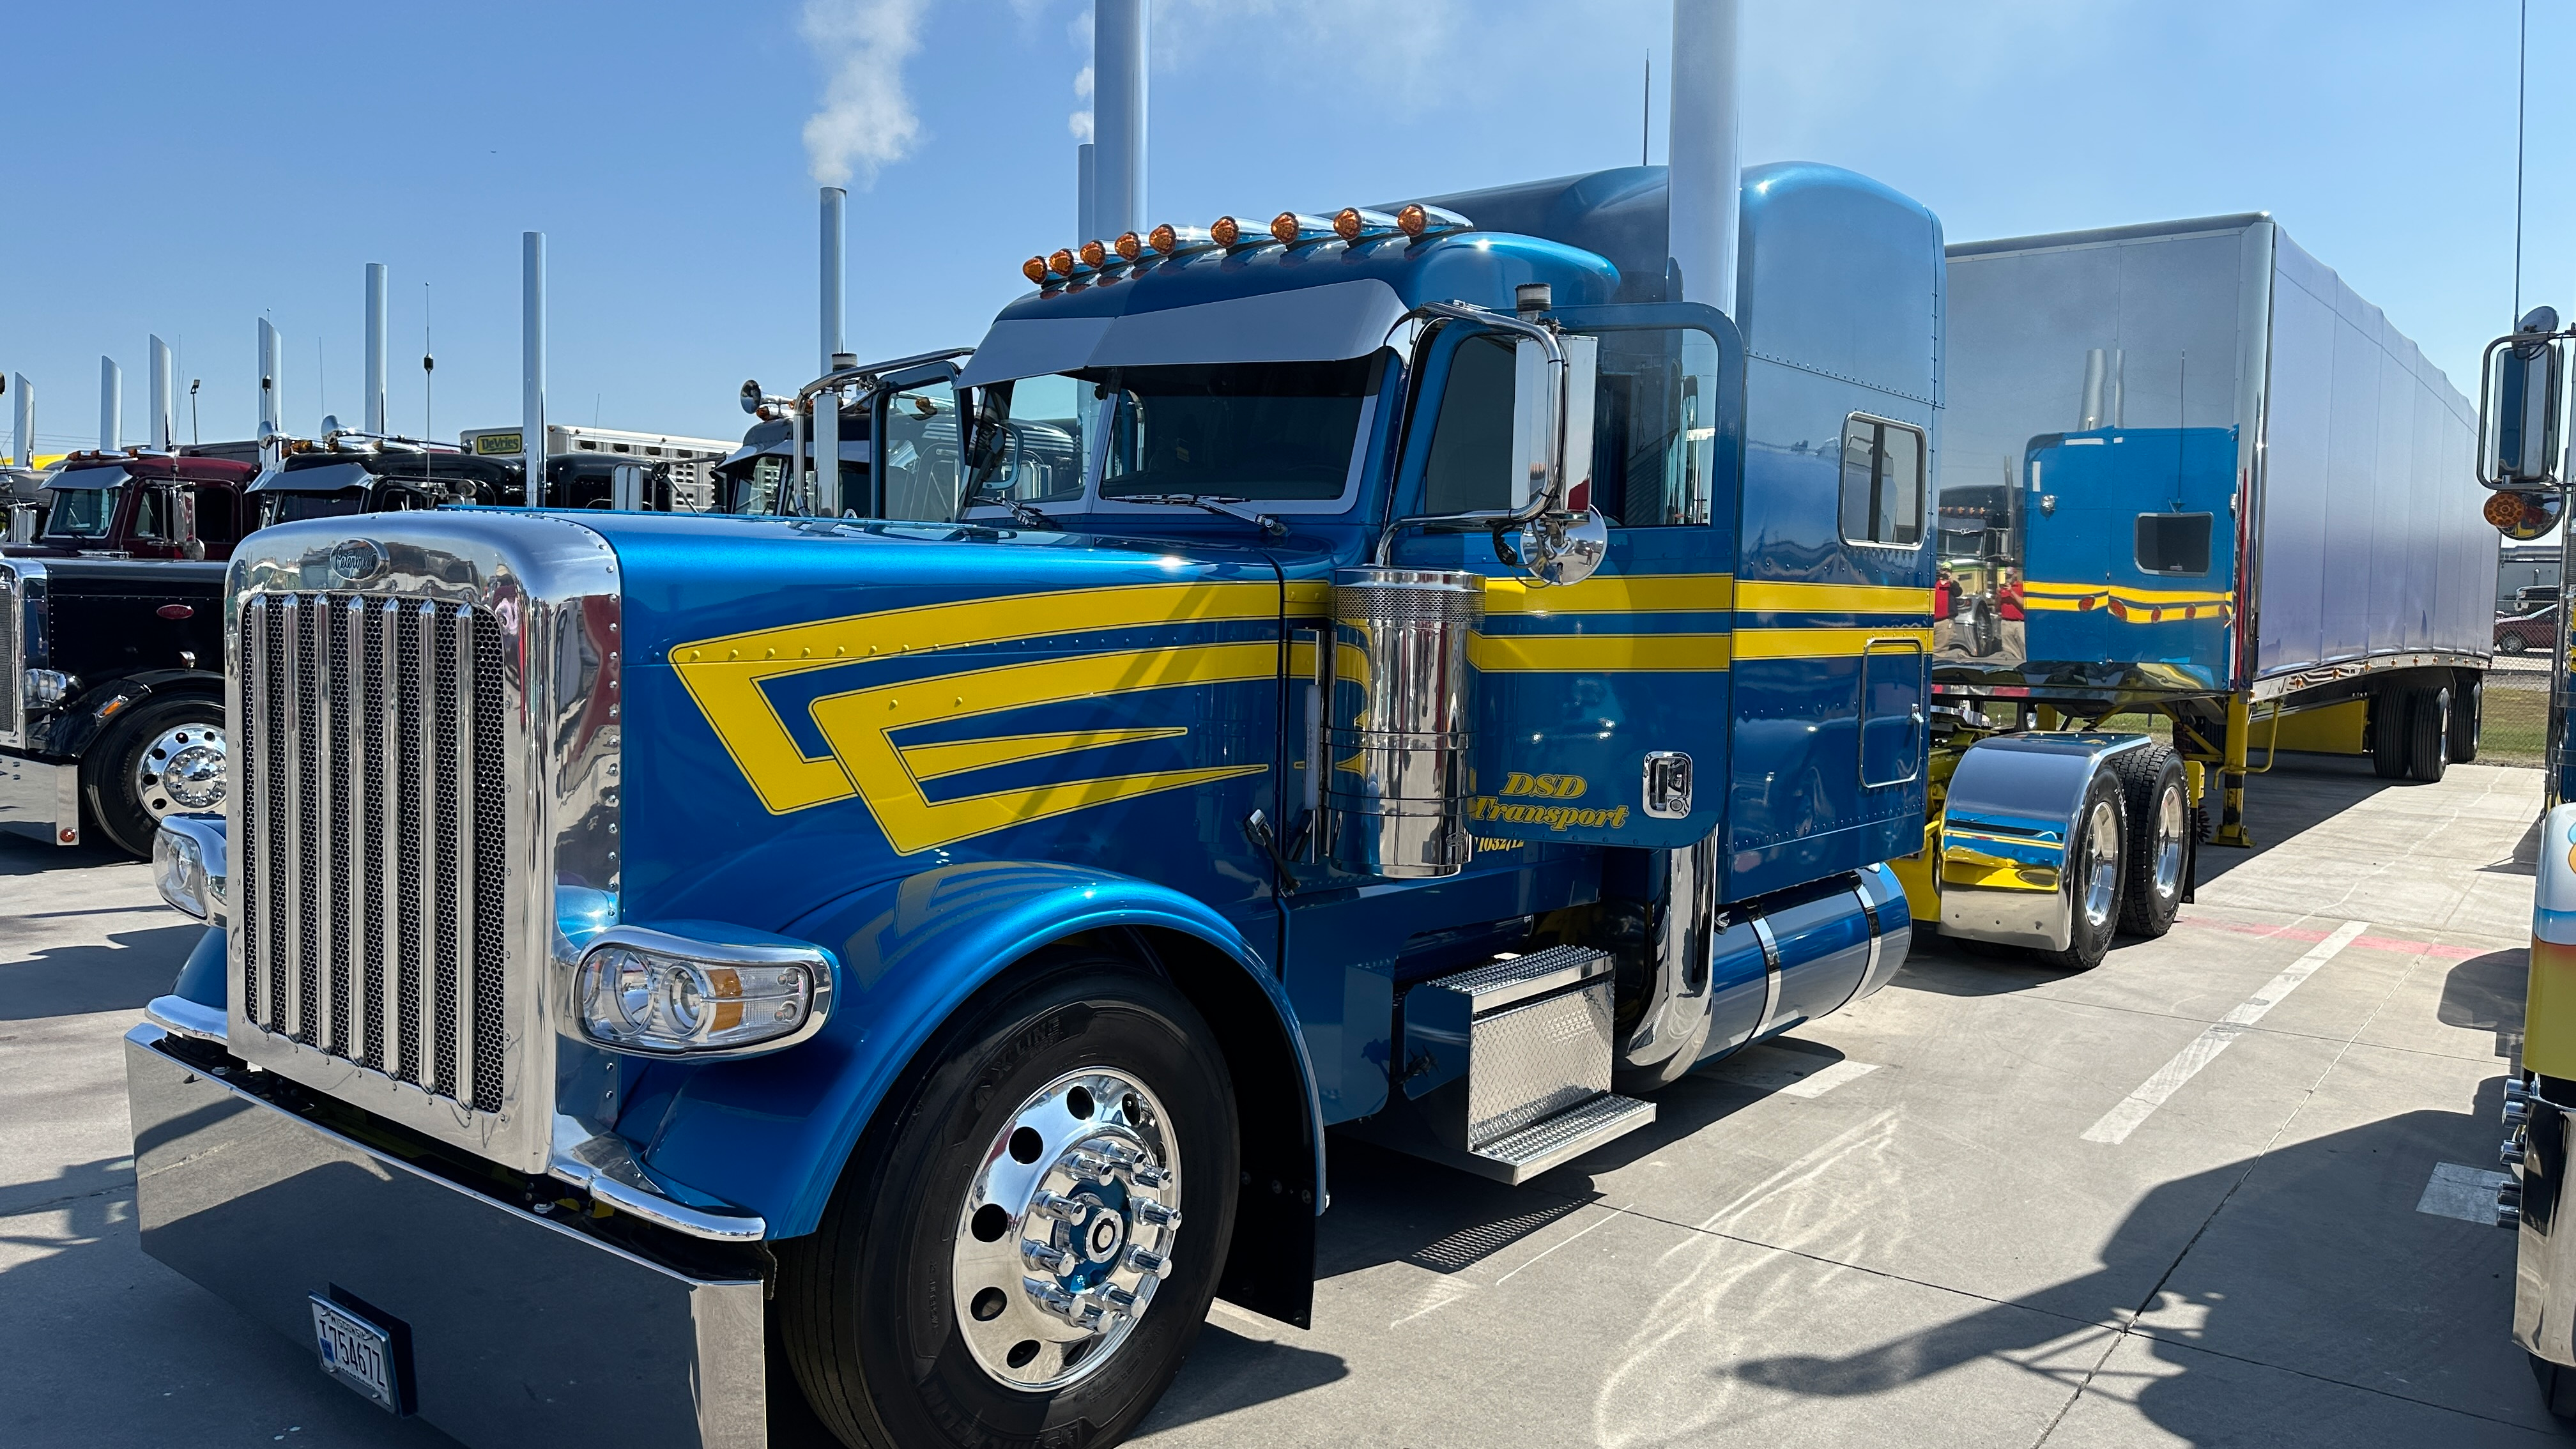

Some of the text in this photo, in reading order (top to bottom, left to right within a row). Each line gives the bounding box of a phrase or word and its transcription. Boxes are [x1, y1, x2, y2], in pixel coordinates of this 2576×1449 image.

[480, 437, 519, 450] DeVries
[335, 546, 378, 571] Peterbilt
[1499, 772, 1587, 799] DSD
[1475, 796, 1629, 831] Transport
[1016, 1016, 1060, 1055] LINE
[331, 1315, 366, 1339] WISCONSIN
[319, 1319, 326, 1337] T
[329, 1326, 385, 1386] 75467Z
